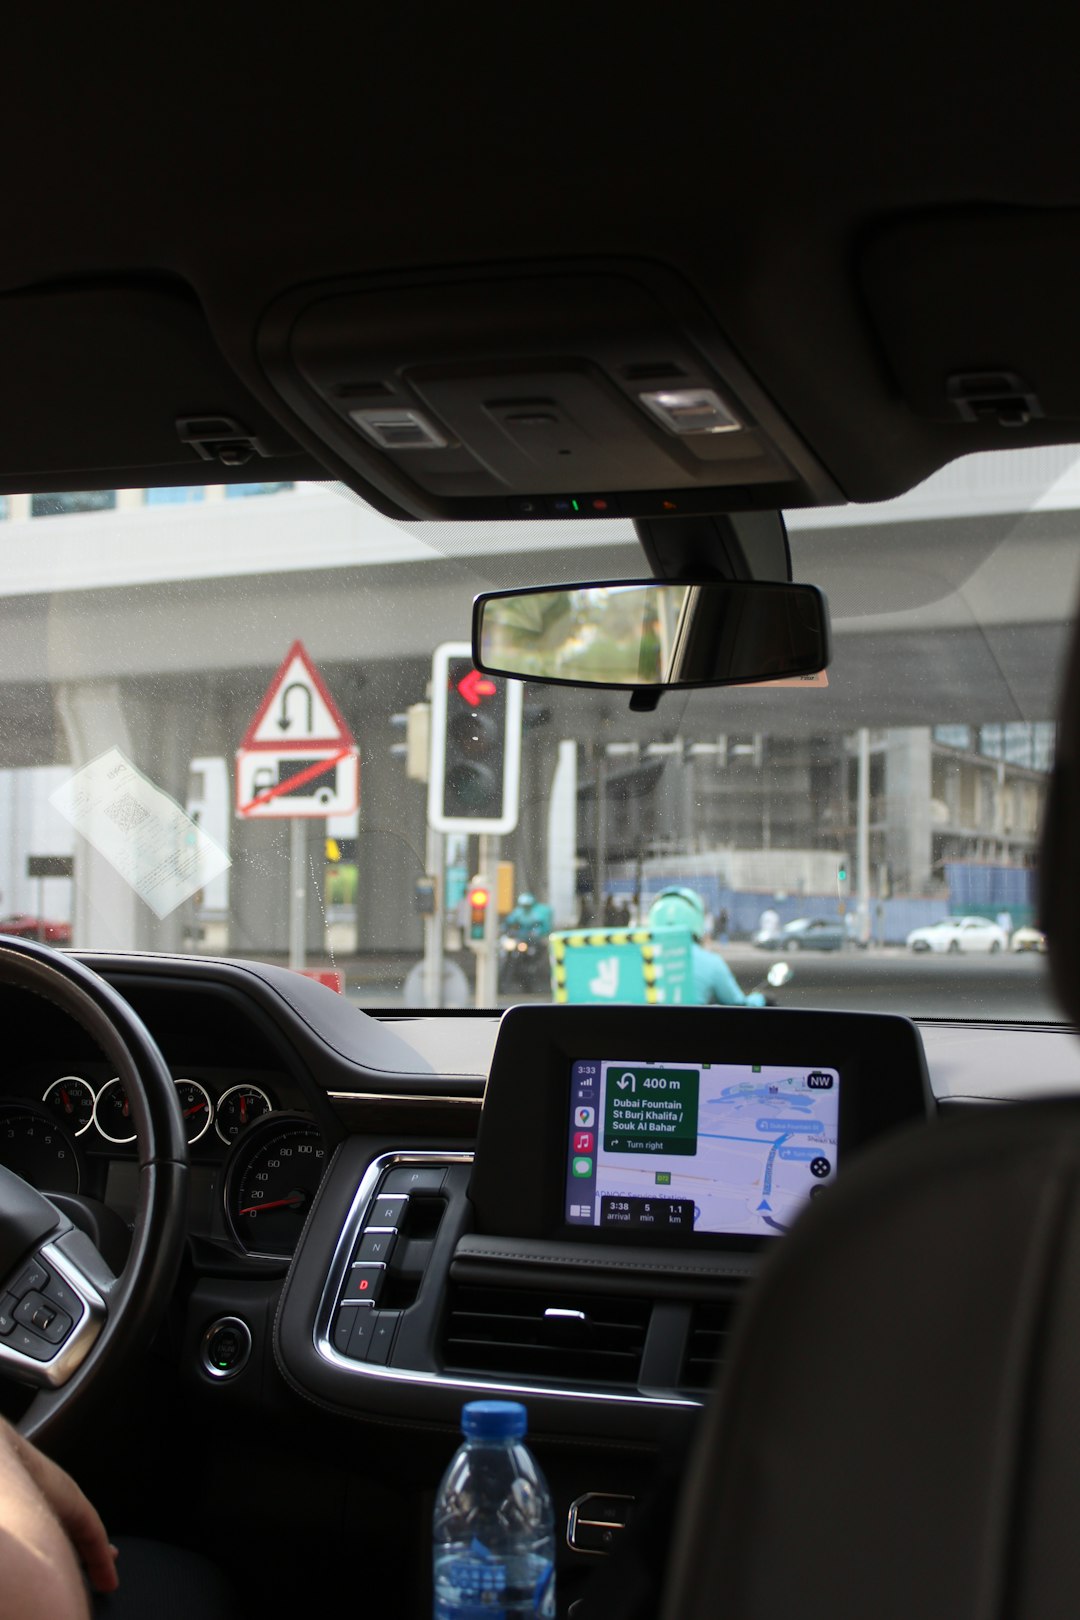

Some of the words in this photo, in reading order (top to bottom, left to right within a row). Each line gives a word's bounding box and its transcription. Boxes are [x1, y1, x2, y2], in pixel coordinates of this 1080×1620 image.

[577, 1066, 596, 1074] 3:33
[643, 1078, 667, 1089] 400
[669, 1080, 680, 1090] m
[810, 1076, 830, 1086] NW
[613, 1098, 640, 1108] Dubai
[641, 1100, 682, 1109] Fountain
[612, 1110, 623, 1118] St
[624, 1110, 644, 1121] Burj
[646, 1111, 678, 1120] Khalifa
[678, 1112, 684, 1122] /
[27, 1128, 34, 1136] 4
[612, 1122, 636, 1130] Souk
[638, 1122, 648, 1130] Al
[648, 1122, 676, 1132] Bahar
[8, 1130, 15, 1138] 3
[45, 1136, 52, 1144] 5
[626, 1140, 644, 1148] Turn
[646, 1141, 664, 1150] right
[58, 1150, 65, 1158] 6
[610, 1202, 629, 1210] 3:38
[644, 1204, 650, 1212] 5
[607, 1212, 630, 1220] arrival
[359, 1280, 368, 1290] D
[358, 1327, 364, 1335] L
